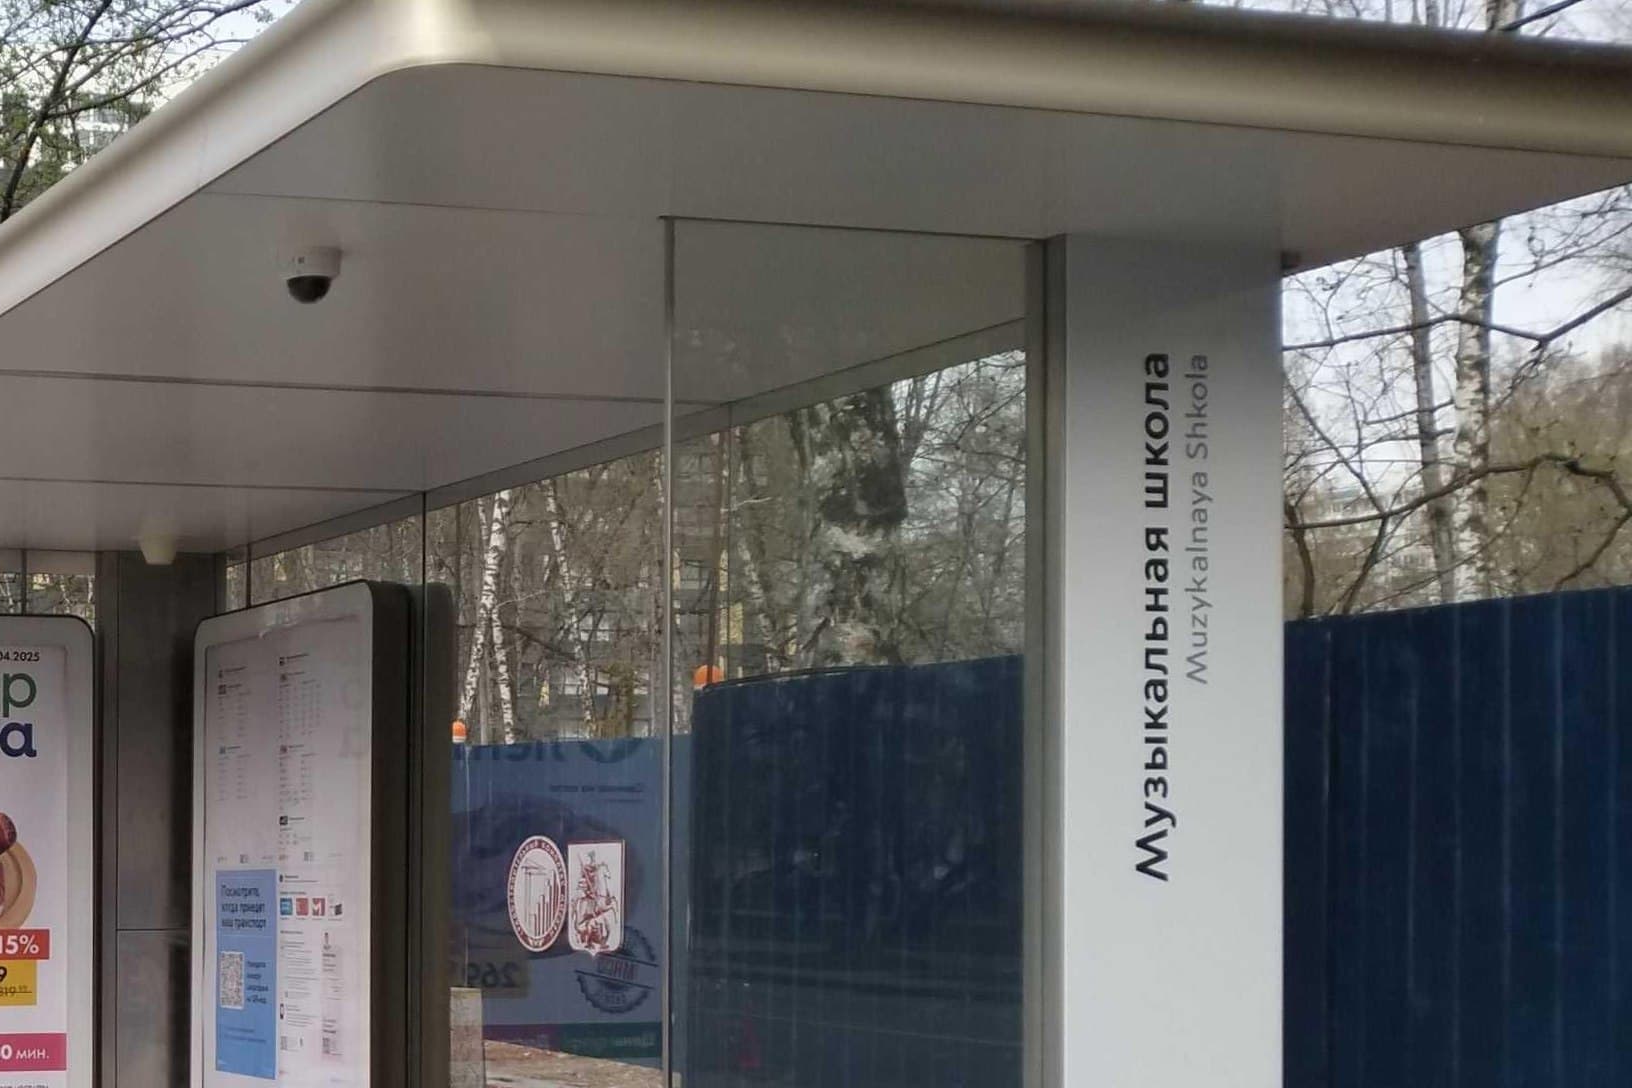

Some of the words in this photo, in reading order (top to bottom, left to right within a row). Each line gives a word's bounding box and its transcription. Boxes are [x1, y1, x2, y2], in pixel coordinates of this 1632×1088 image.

[1144, 352, 1171, 508] школа
[1184, 354, 1209, 460] Shkola
[1184, 471, 1214, 685] Muzykalnaya
[1135, 527, 1177, 882] Музыкальная
[16, 1048, 50, 1060] мин.
